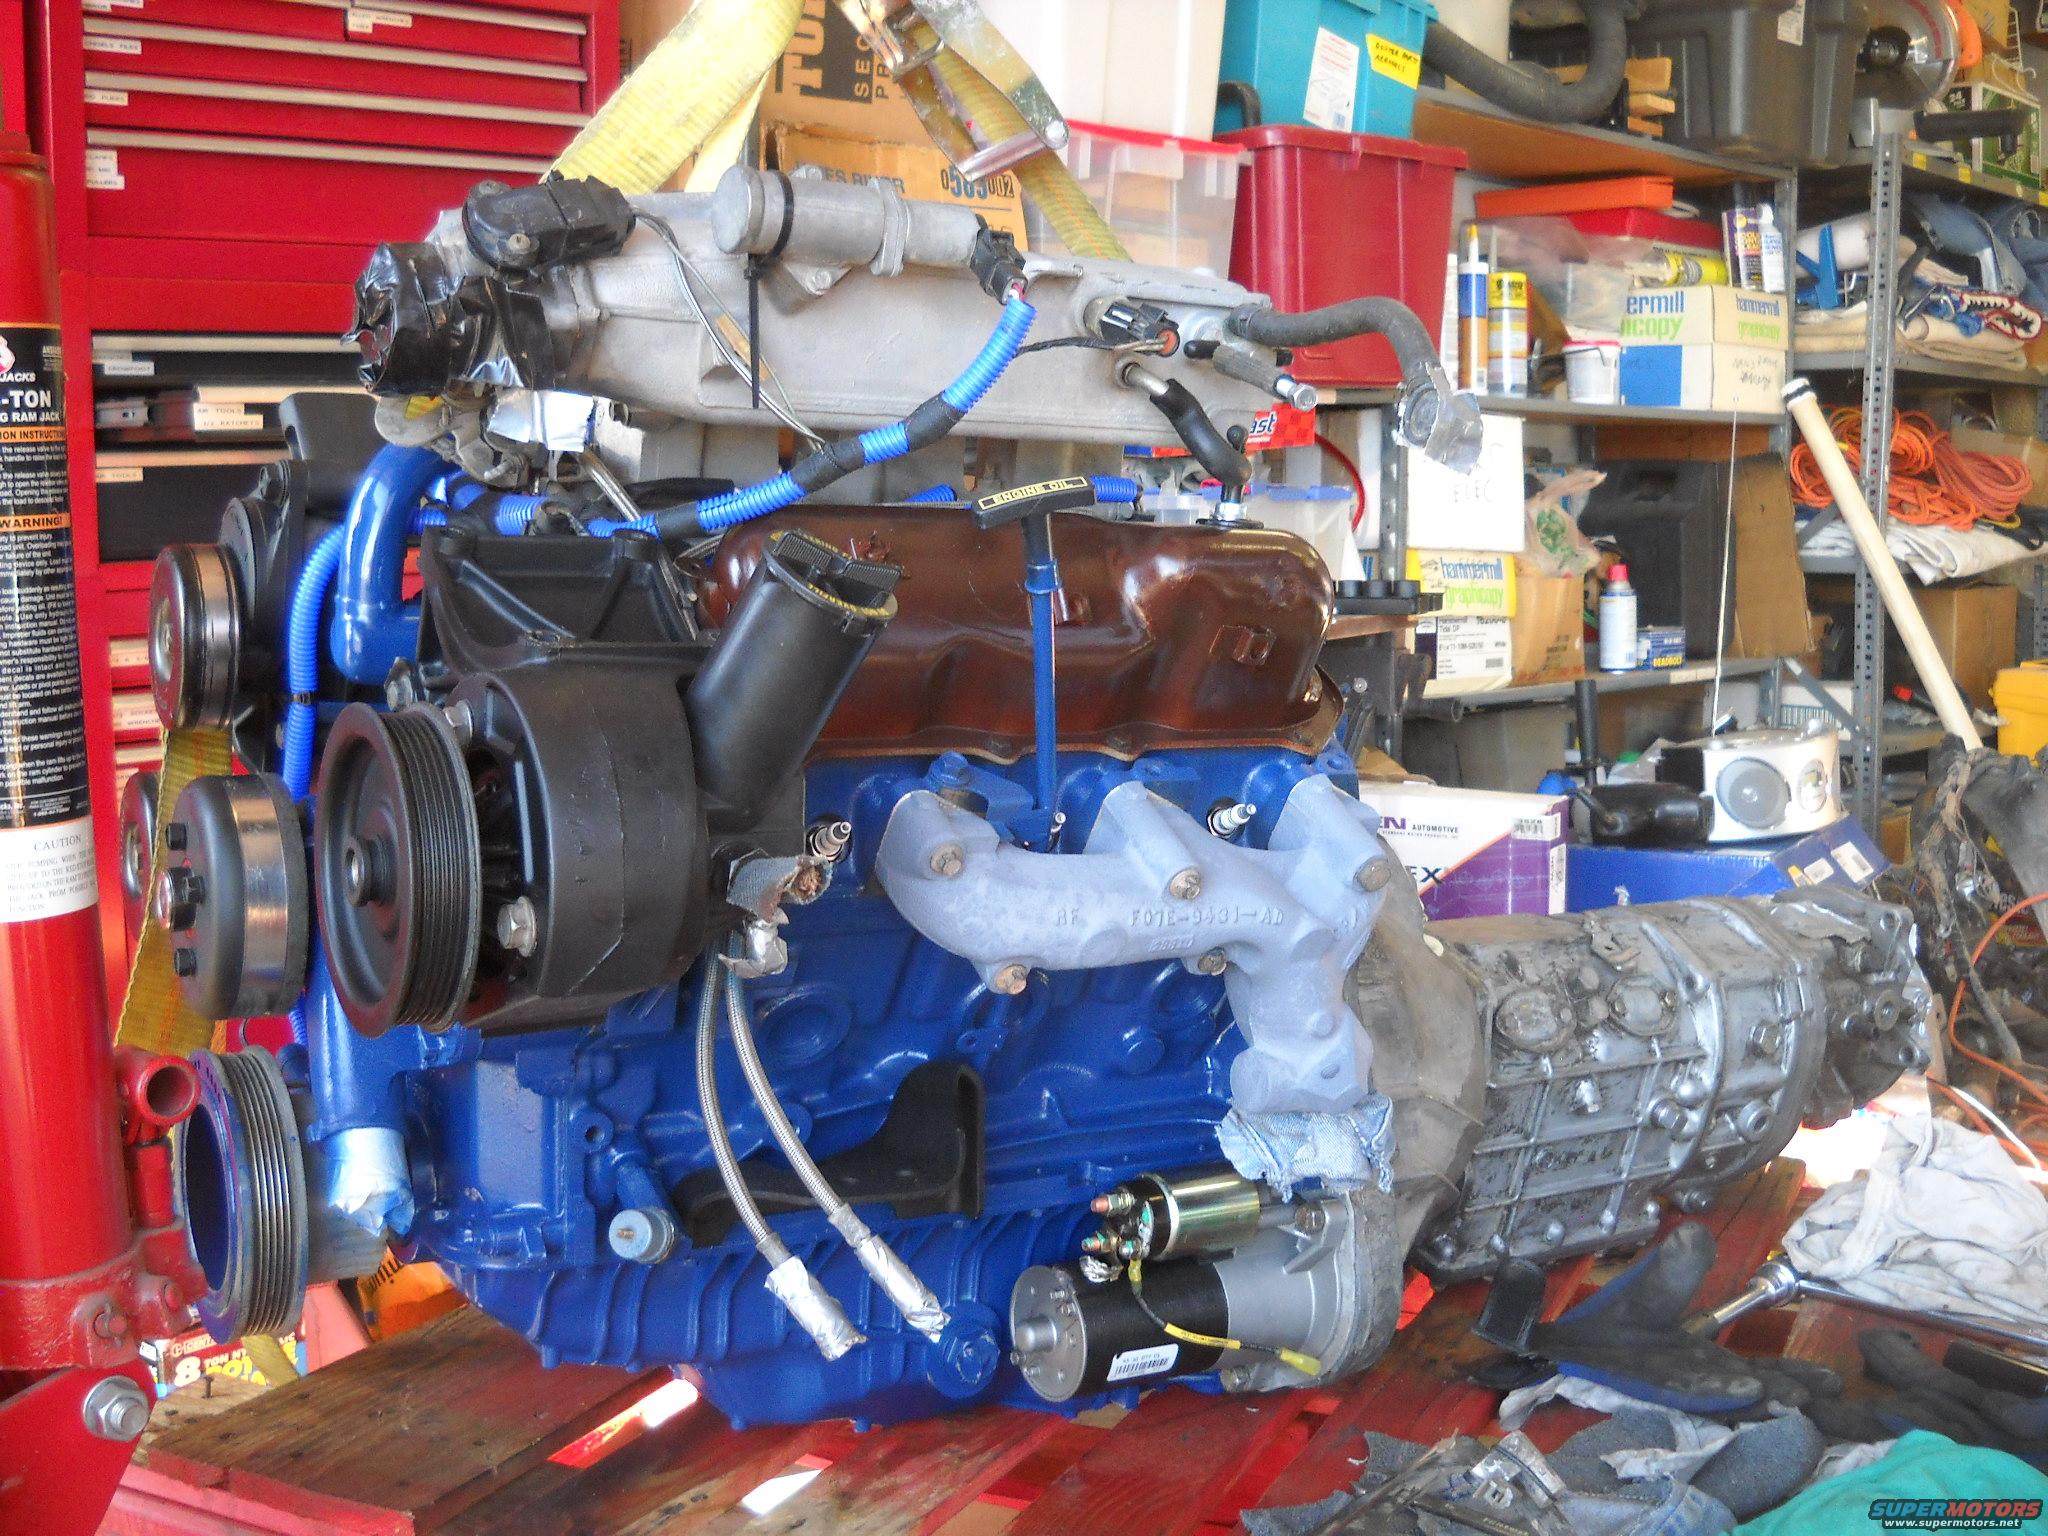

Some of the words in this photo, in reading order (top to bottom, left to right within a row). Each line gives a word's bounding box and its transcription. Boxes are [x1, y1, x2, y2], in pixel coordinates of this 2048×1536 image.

[0, 372, 36, 382] JACKS
[12, 412, 38, 422] RAM
[40, 411, 61, 422] JACK
[996, 485, 1043, 502] ENGINE
[1050, 480, 1073, 490] OIL
[1440, 556, 1503, 580] hammermill
[1412, 824, 1459, 834] AUTOMOTIVE
[33, 834, 82, 851] CAUTION
[174, 1356, 201, 1387] 8
